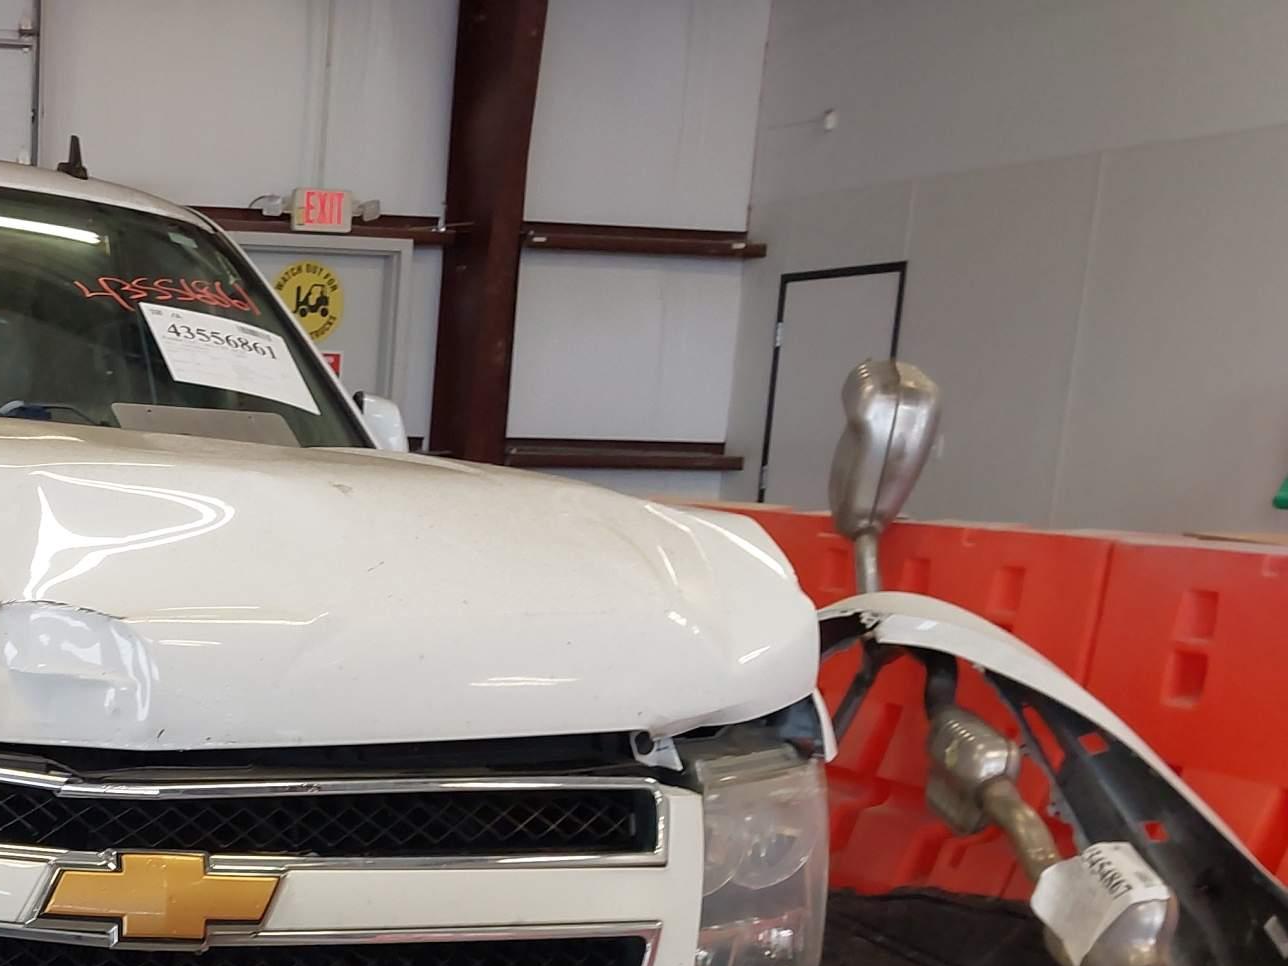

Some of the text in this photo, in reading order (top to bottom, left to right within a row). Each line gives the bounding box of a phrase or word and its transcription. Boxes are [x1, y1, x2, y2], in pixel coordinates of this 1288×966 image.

[304, 191, 345, 225] EXIT
[274, 263, 339, 294] WATCH OUT FOR
[167, 323, 277, 360] 43556861
